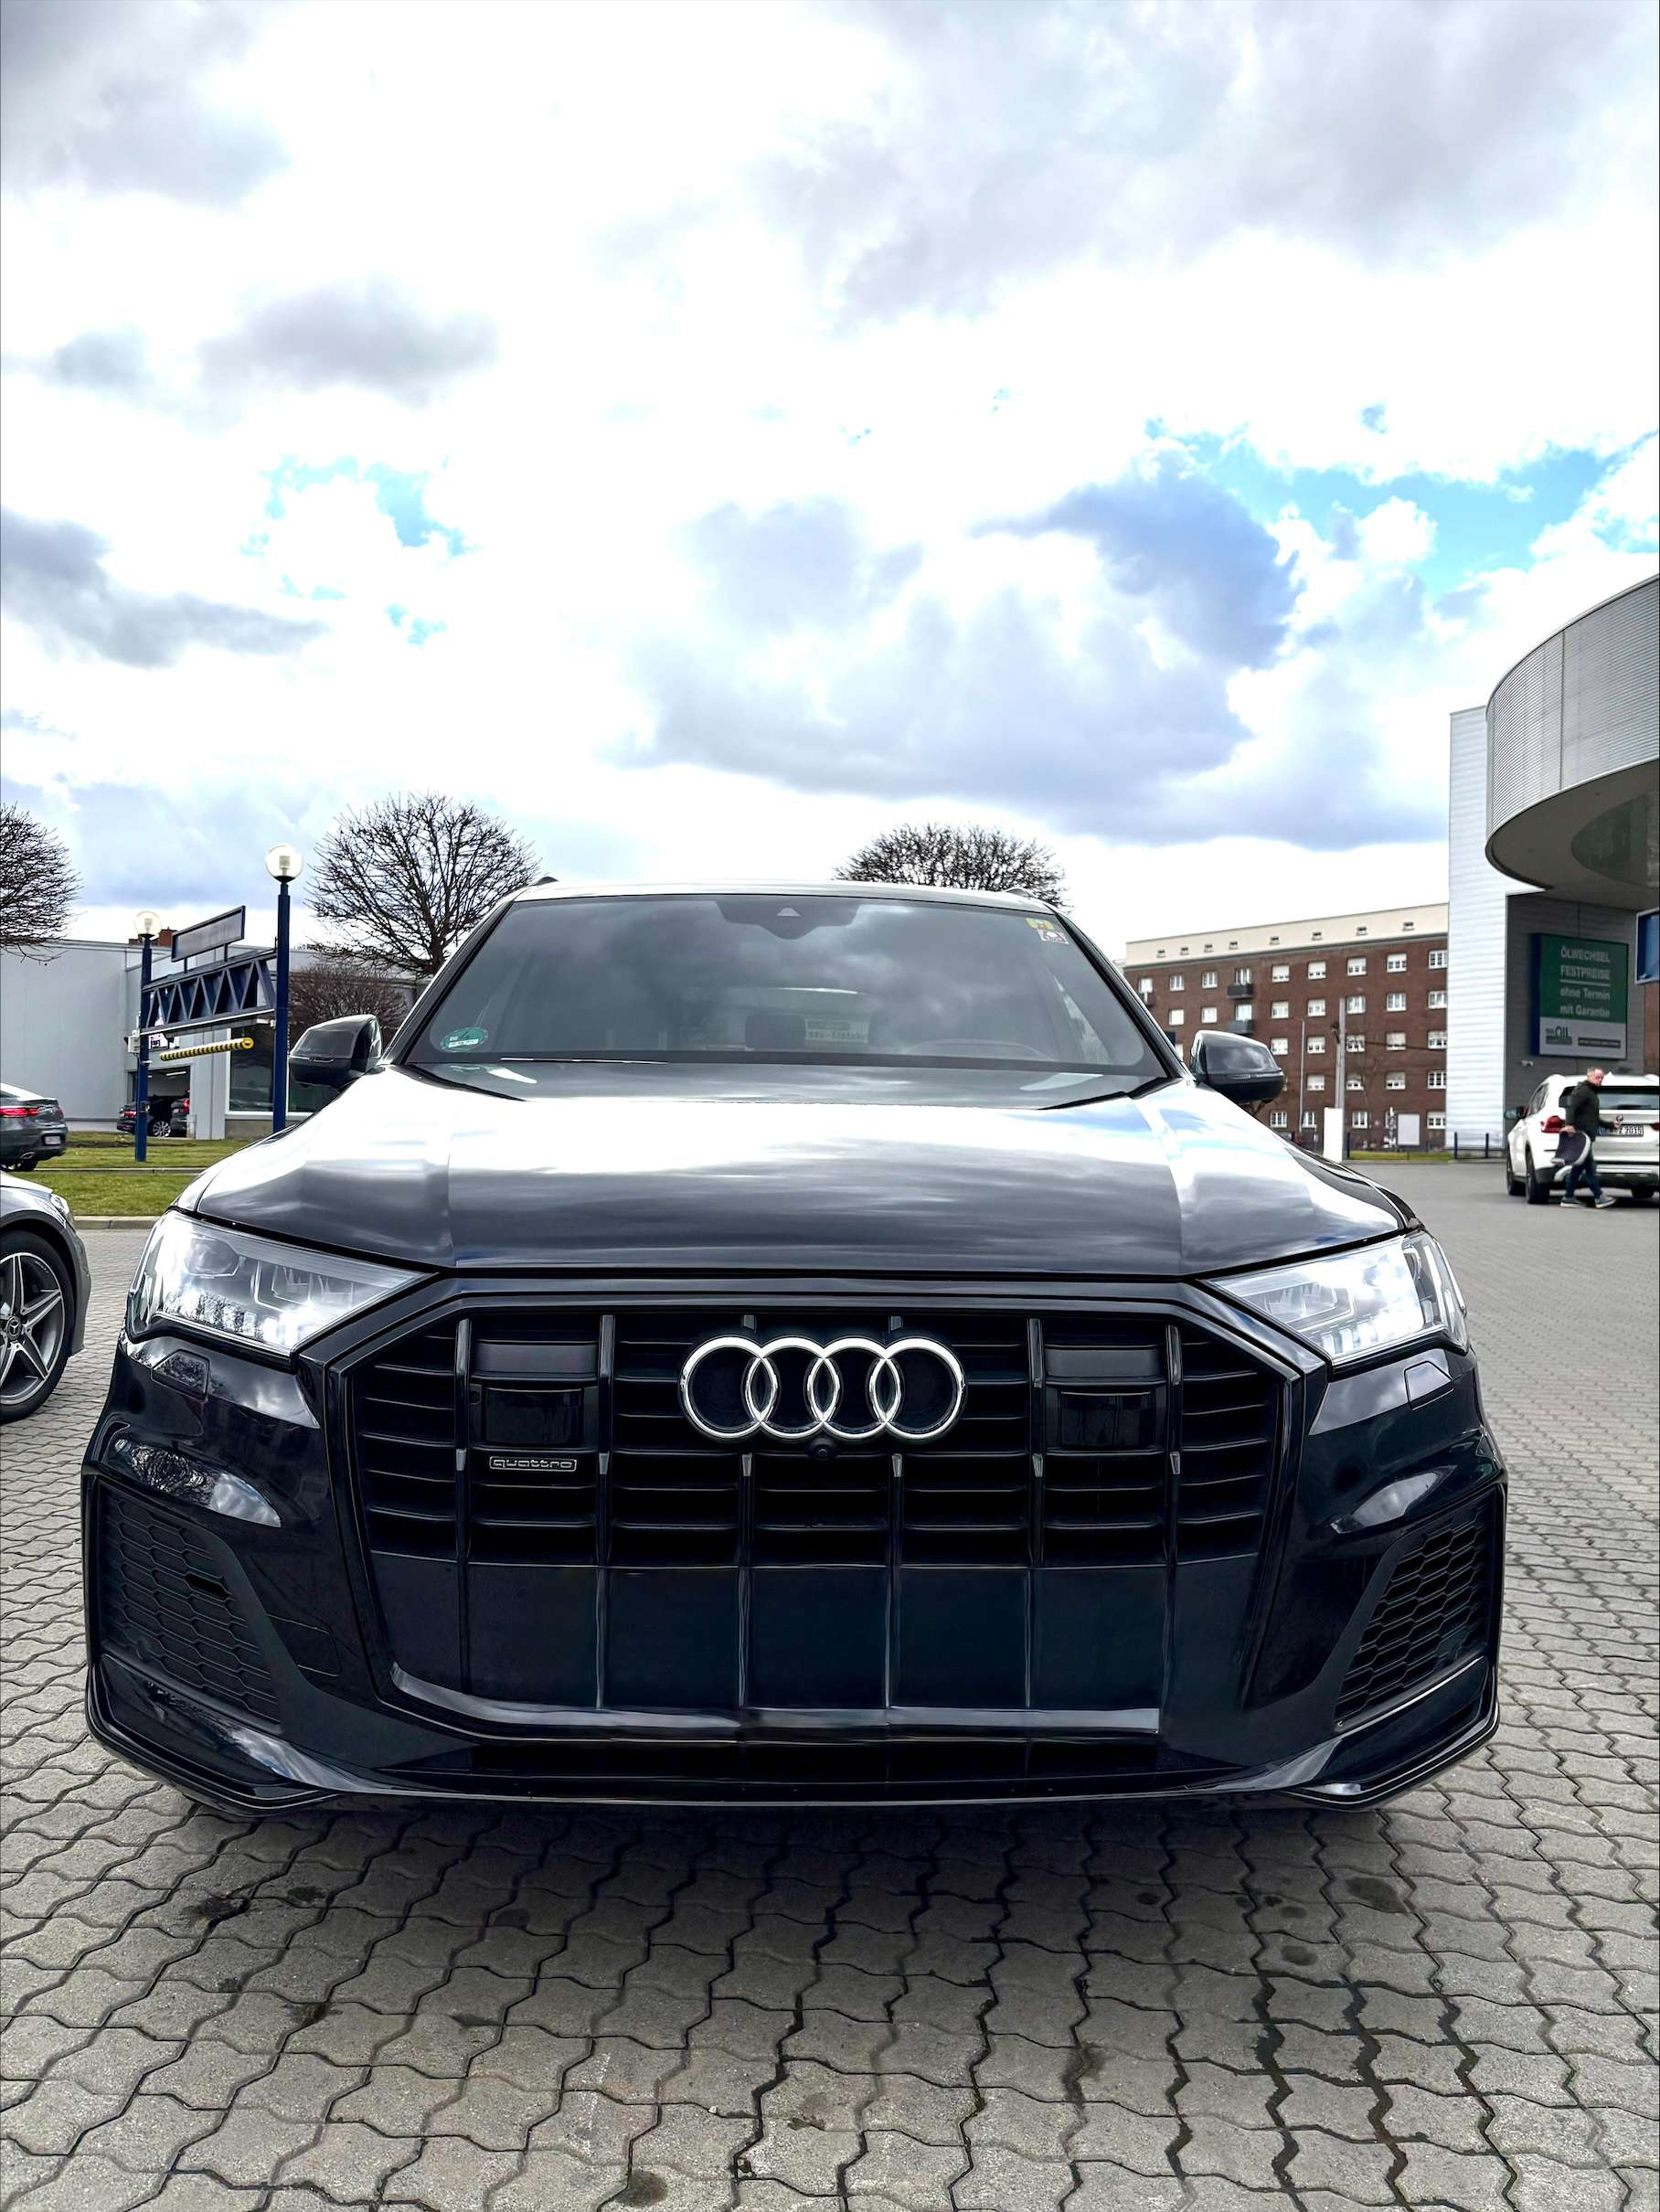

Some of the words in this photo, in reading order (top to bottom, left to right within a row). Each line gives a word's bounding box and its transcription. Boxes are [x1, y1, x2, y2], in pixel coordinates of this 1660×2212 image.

[1560, 945, 1610, 962] ÖLWECHSEL
[1560, 965, 1610, 981] FESTPREISE
[1560, 987, 1580, 998] ohne
[1583, 988, 1610, 1001] Termin
[1560, 1005, 1573, 1015] mit
[1576, 1005, 1610, 1018] Garantie
[493, 1459, 573, 1469] quattro
